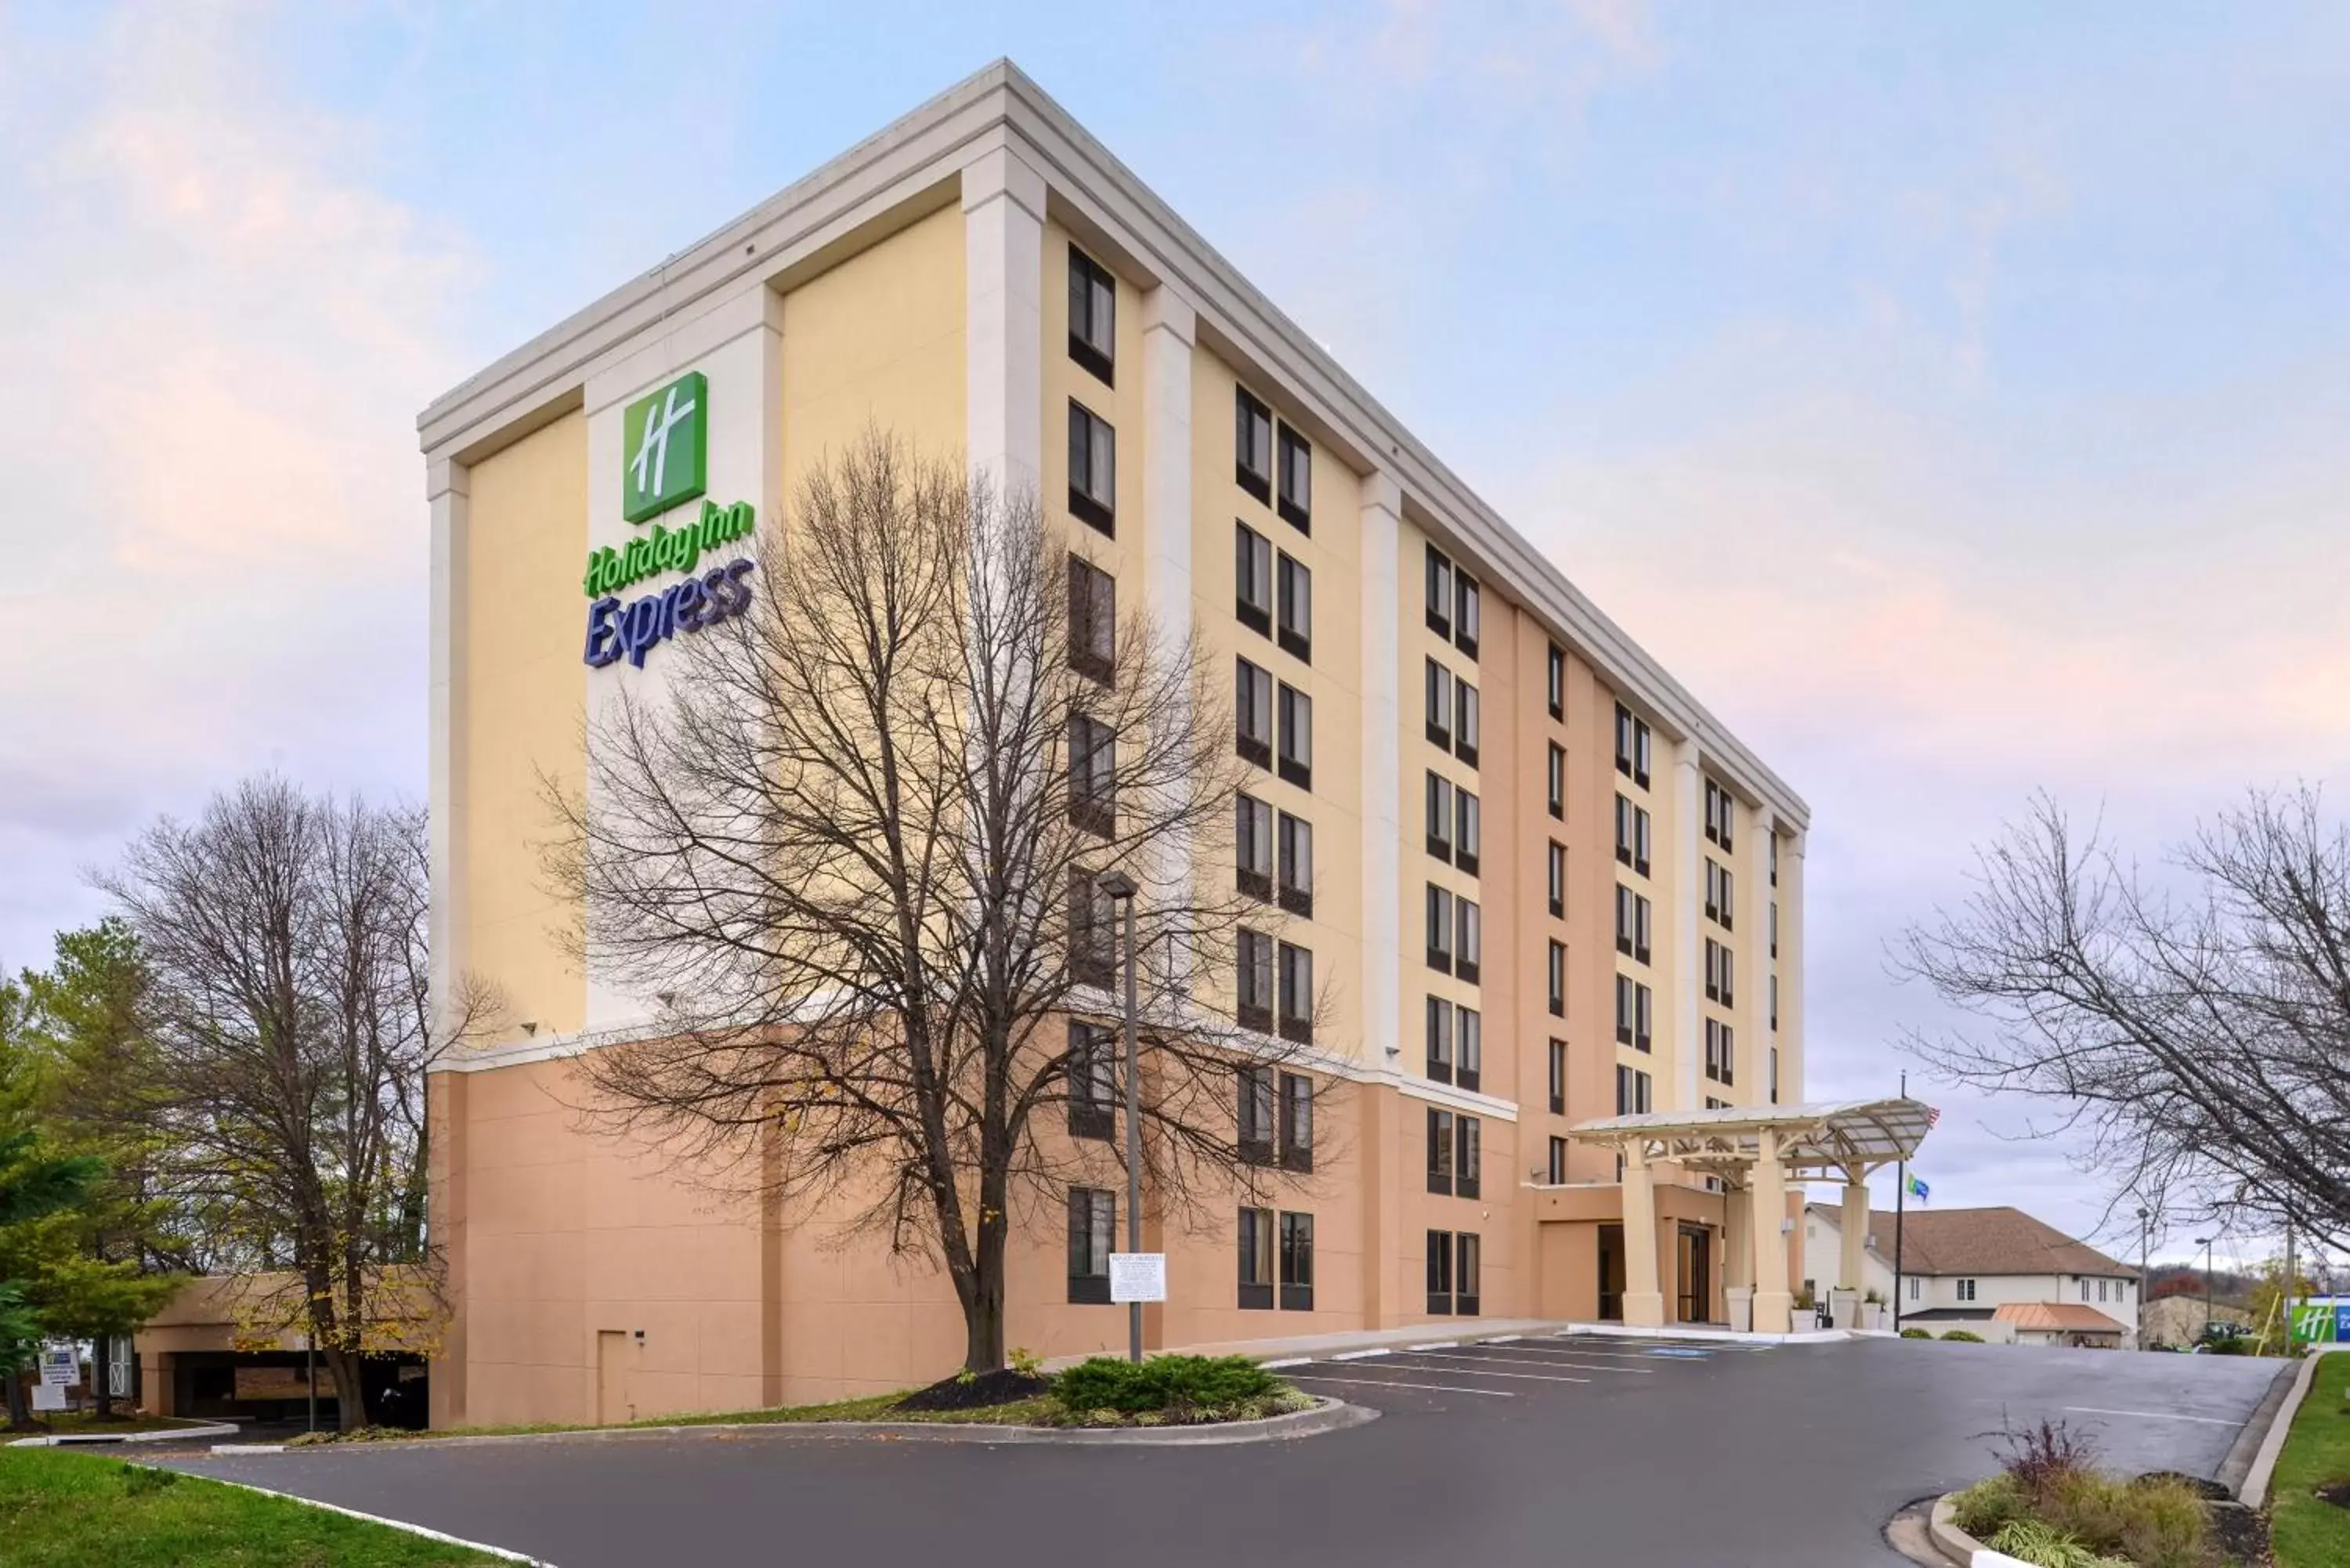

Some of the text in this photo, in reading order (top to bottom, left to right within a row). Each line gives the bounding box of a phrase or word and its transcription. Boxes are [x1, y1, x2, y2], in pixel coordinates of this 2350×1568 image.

[630, 387, 696, 497] H
[584, 500, 754, 599] Holiday Inn
[584, 558, 754, 670] Express
[2296, 1308, 2334, 1339] H
